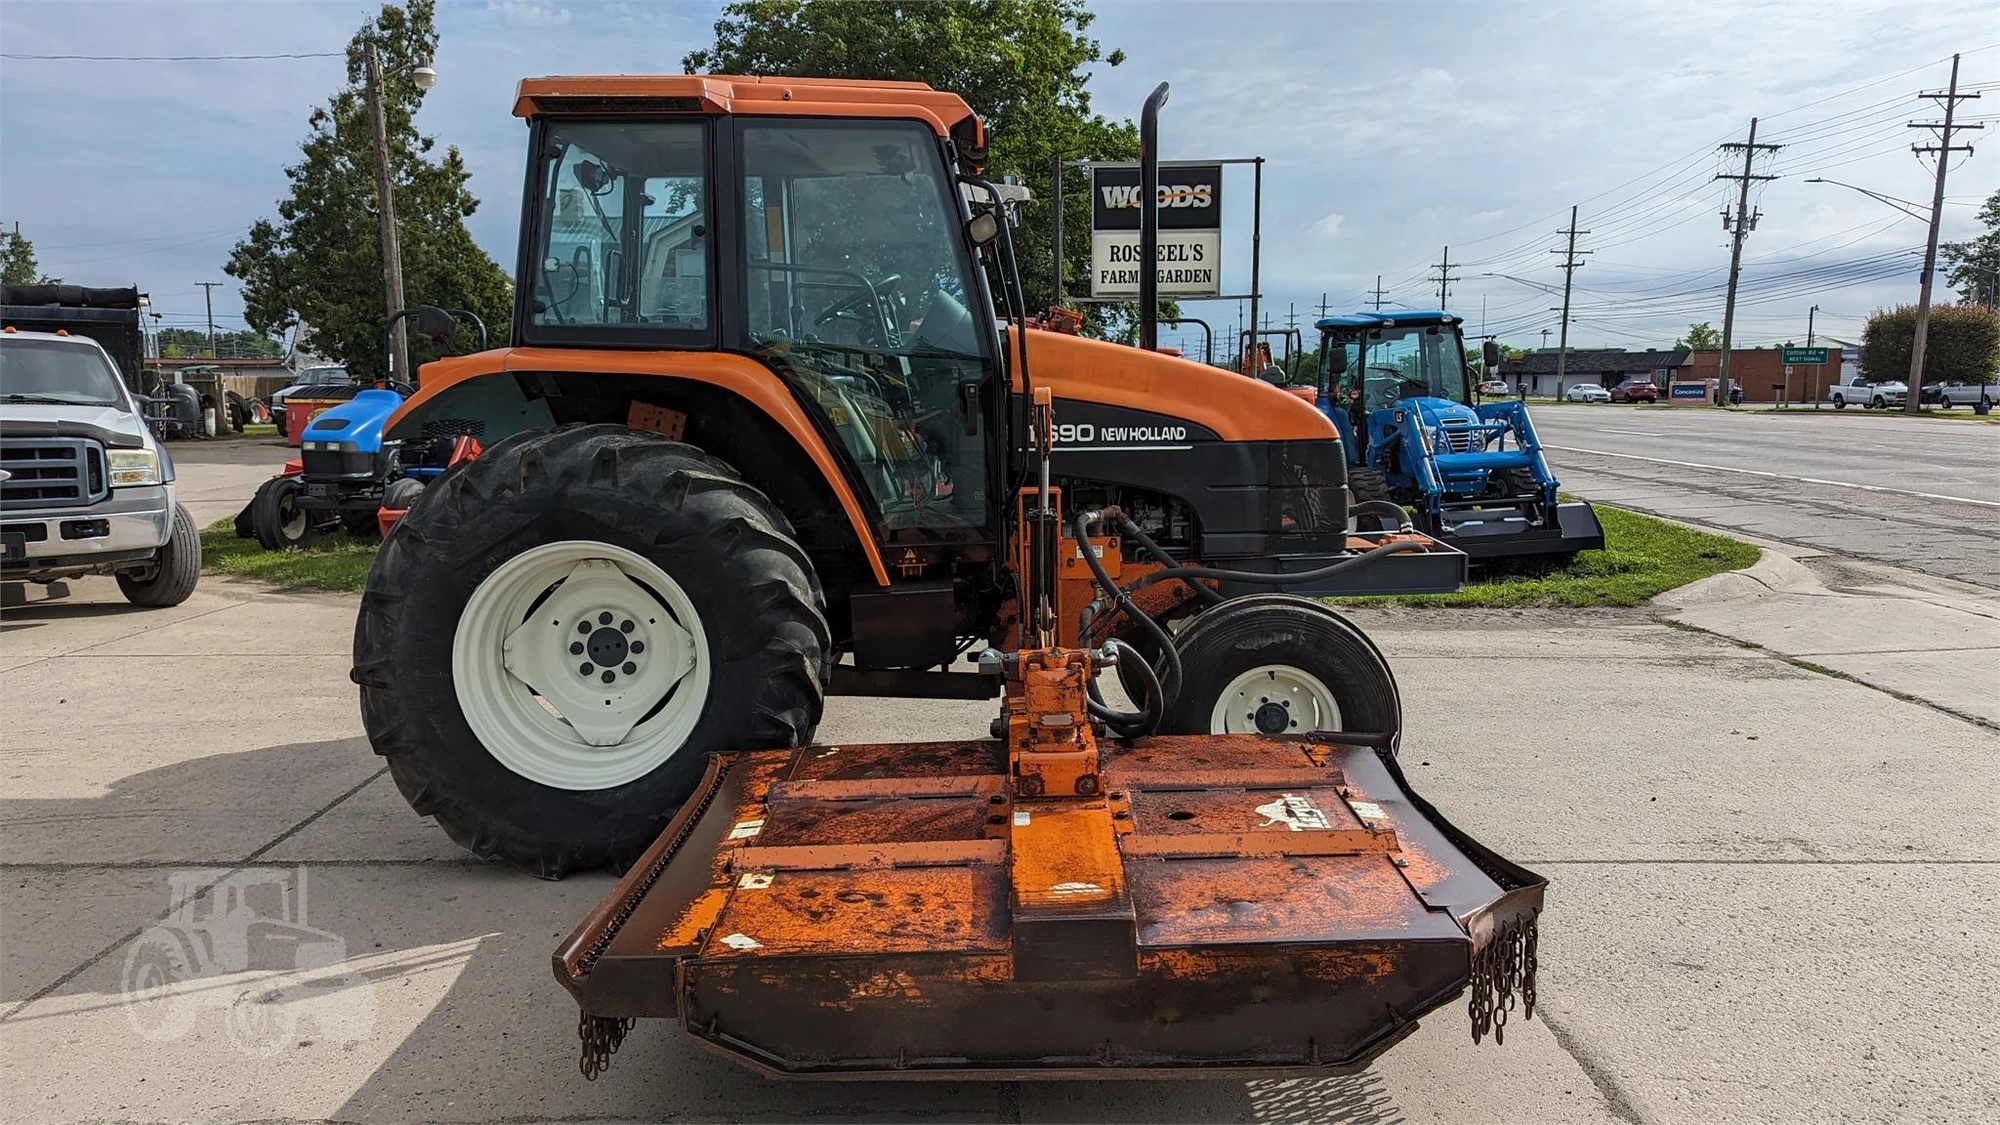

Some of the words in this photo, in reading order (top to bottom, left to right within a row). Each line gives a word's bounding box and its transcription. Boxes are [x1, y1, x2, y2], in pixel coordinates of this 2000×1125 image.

[1101, 185, 1211, 208] WOODS
[1109, 244, 1204, 262] ROSEEL'S
[1100, 270, 1139, 284] FARM
[1157, 269, 1212, 284] GARDEN
[1101, 427, 1128, 441] NEW
[1129, 427, 1186, 440] HOLLAND
